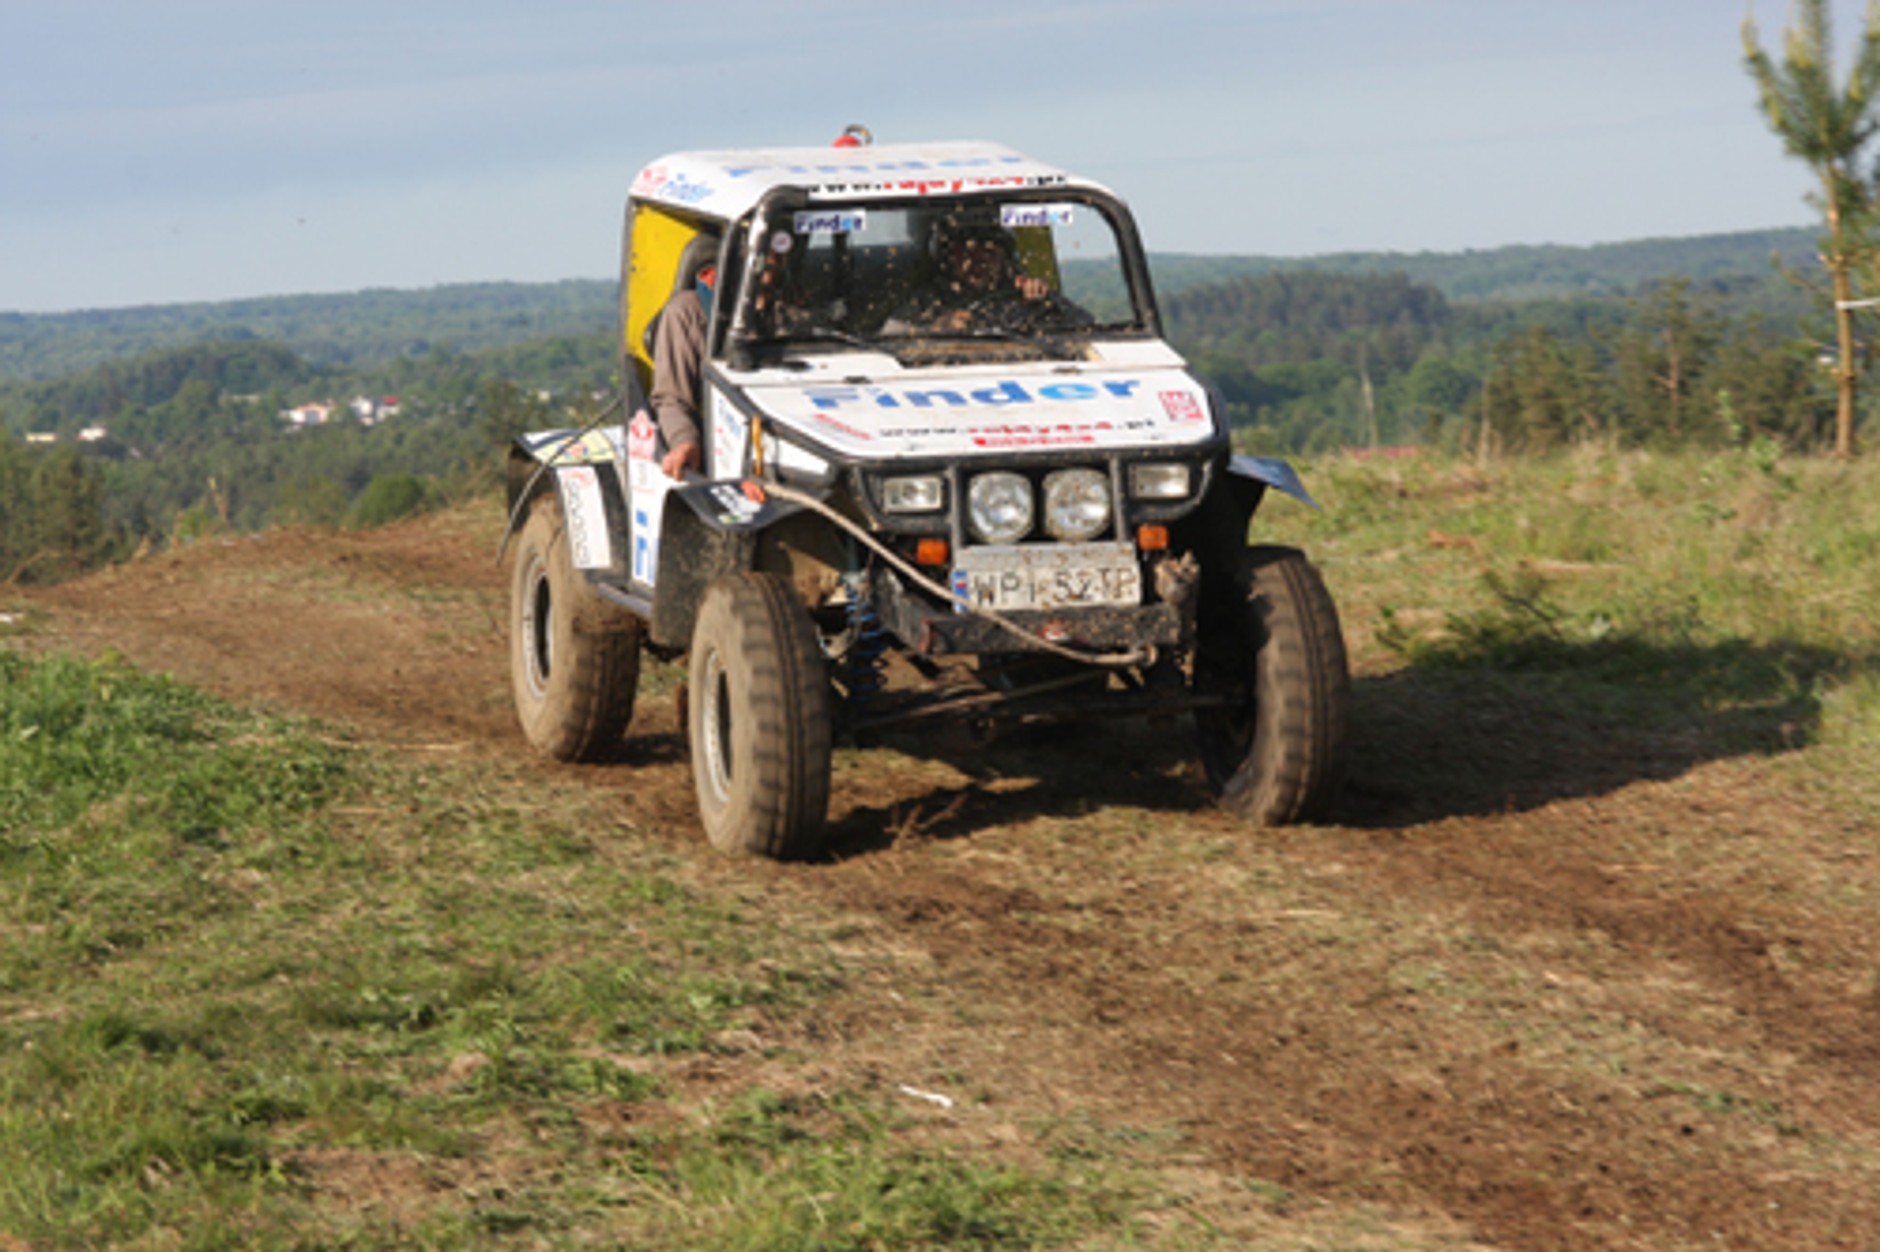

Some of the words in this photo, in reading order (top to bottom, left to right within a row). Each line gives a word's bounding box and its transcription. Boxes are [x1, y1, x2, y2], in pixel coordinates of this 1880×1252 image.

[796, 213, 863, 232] Finder
[1003, 208, 1069, 226] Finder
[802, 379, 1141, 409] Finder
